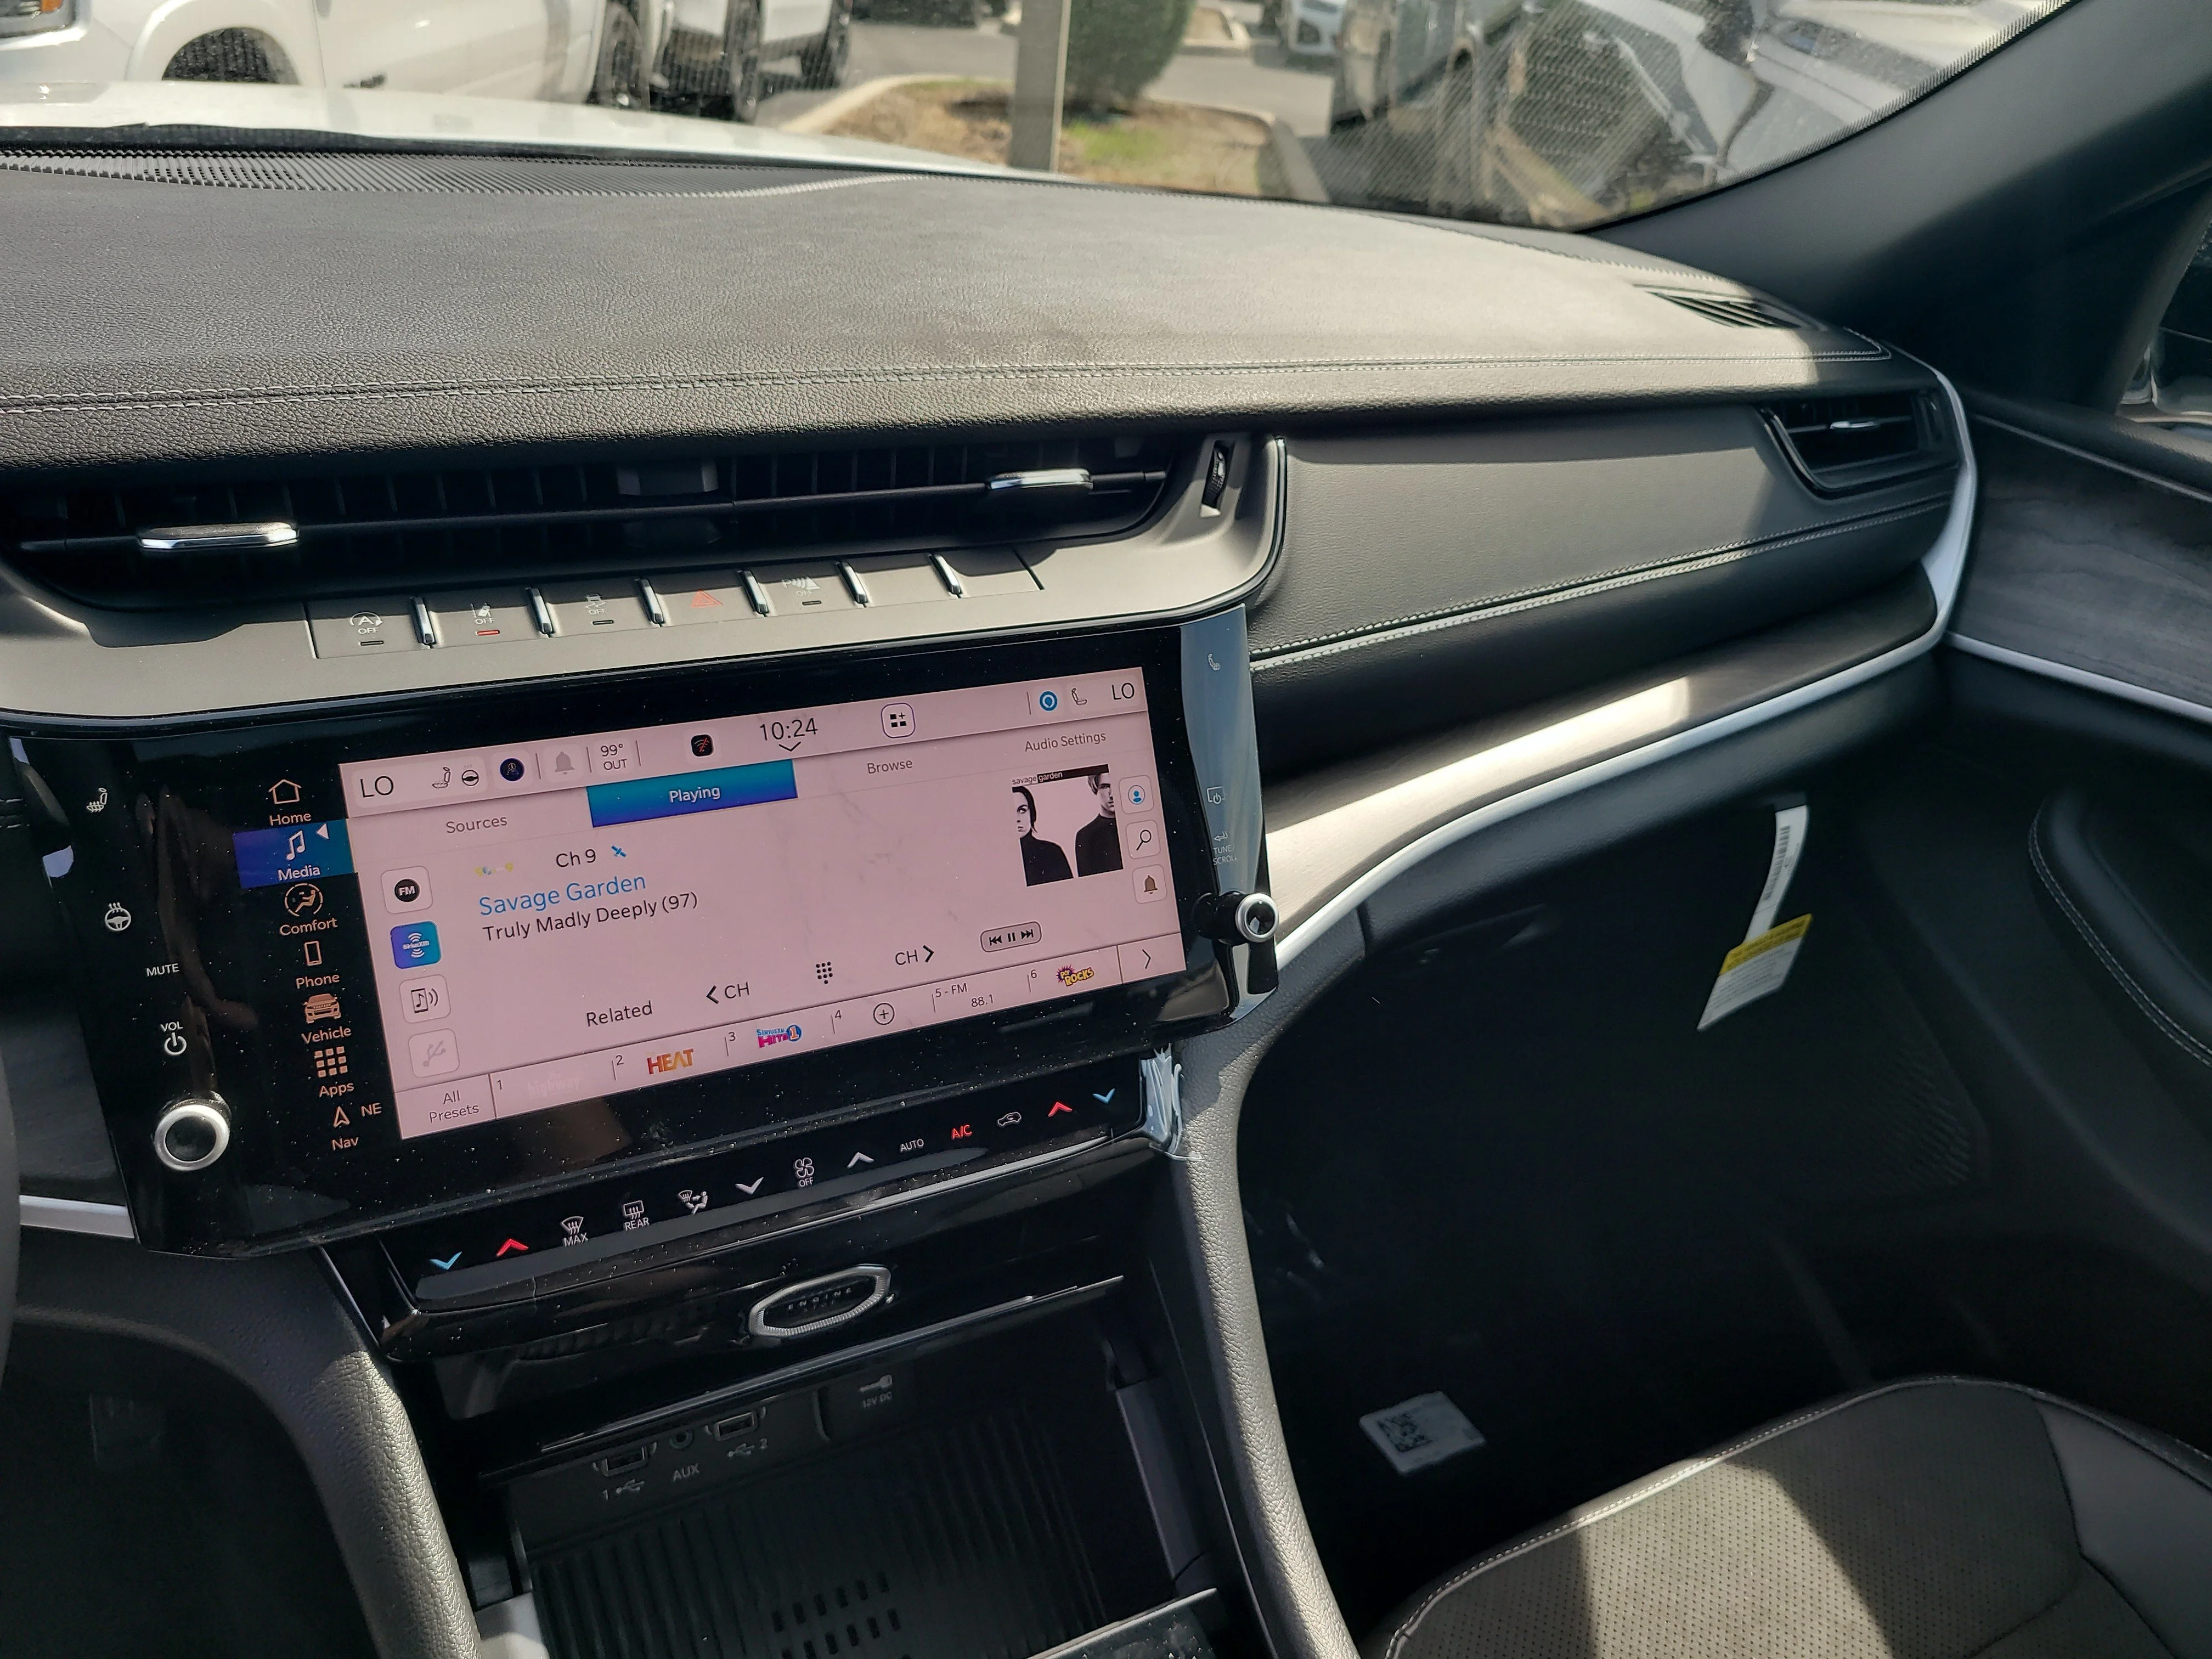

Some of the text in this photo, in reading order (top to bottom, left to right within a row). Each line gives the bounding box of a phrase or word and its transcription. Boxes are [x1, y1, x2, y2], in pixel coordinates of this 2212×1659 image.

[1111, 682, 1135, 700] LO
[760, 718, 819, 741] 10:24
[1024, 732, 1107, 752] Audio Settings
[603, 758, 628, 771] OUT
[867, 759, 913, 775] Browse
[1012, 772, 1063, 785] savage garden
[359, 775, 394, 799] LO
[668, 786, 721, 804] Playing
[269, 813, 312, 826] Home
[445, 815, 508, 834] Sources
[555, 849, 597, 868] Ch 9
[278, 865, 321, 881] Media
[398, 885, 416, 896] FM
[478, 876, 646, 916] Savage Garden
[482, 891, 698, 941] Truly Madly Deeply (97)
[279, 917, 338, 936] Comfort
[895, 949, 918, 966] CH
[146, 963, 180, 977] MUTE
[1030, 969, 1037, 979] 6
[1064, 967, 1094, 986] ROCKS
[295, 974, 340, 989] Phone
[724, 981, 750, 999] CH
[935, 988, 941, 998] 5
[952, 983, 968, 995] FM
[971, 994, 994, 1008] 88.1
[586, 1000, 653, 1027] Related
[834, 1010, 842, 1019] 4
[160, 1021, 184, 1032] VOL
[301, 1026, 352, 1045] Vehicle
[729, 1031, 736, 1042] 3
[616, 1054, 624, 1066] 2
[647, 1048, 694, 1075] HEAT
[319, 1082, 354, 1098] Apps
[497, 1079, 503, 1091] 1
[443, 1090, 460, 1104] All
[360, 1102, 382, 1117] NE
[430, 1104, 479, 1123] Presets
[951, 1125, 972, 1141] A/C
[331, 1137, 358, 1151] Nav
[899, 1138, 924, 1153] AUTO
[799, 1177, 814, 1188] OFF
[624, 1217, 650, 1232] REAR
[563, 1232, 589, 1248] MAX
[862, 1391, 893, 1408] 12V DC
[759, 1438, 768, 1450] 2
[673, 1463, 700, 1482] AUX
[602, 1489, 608, 1500] 1
